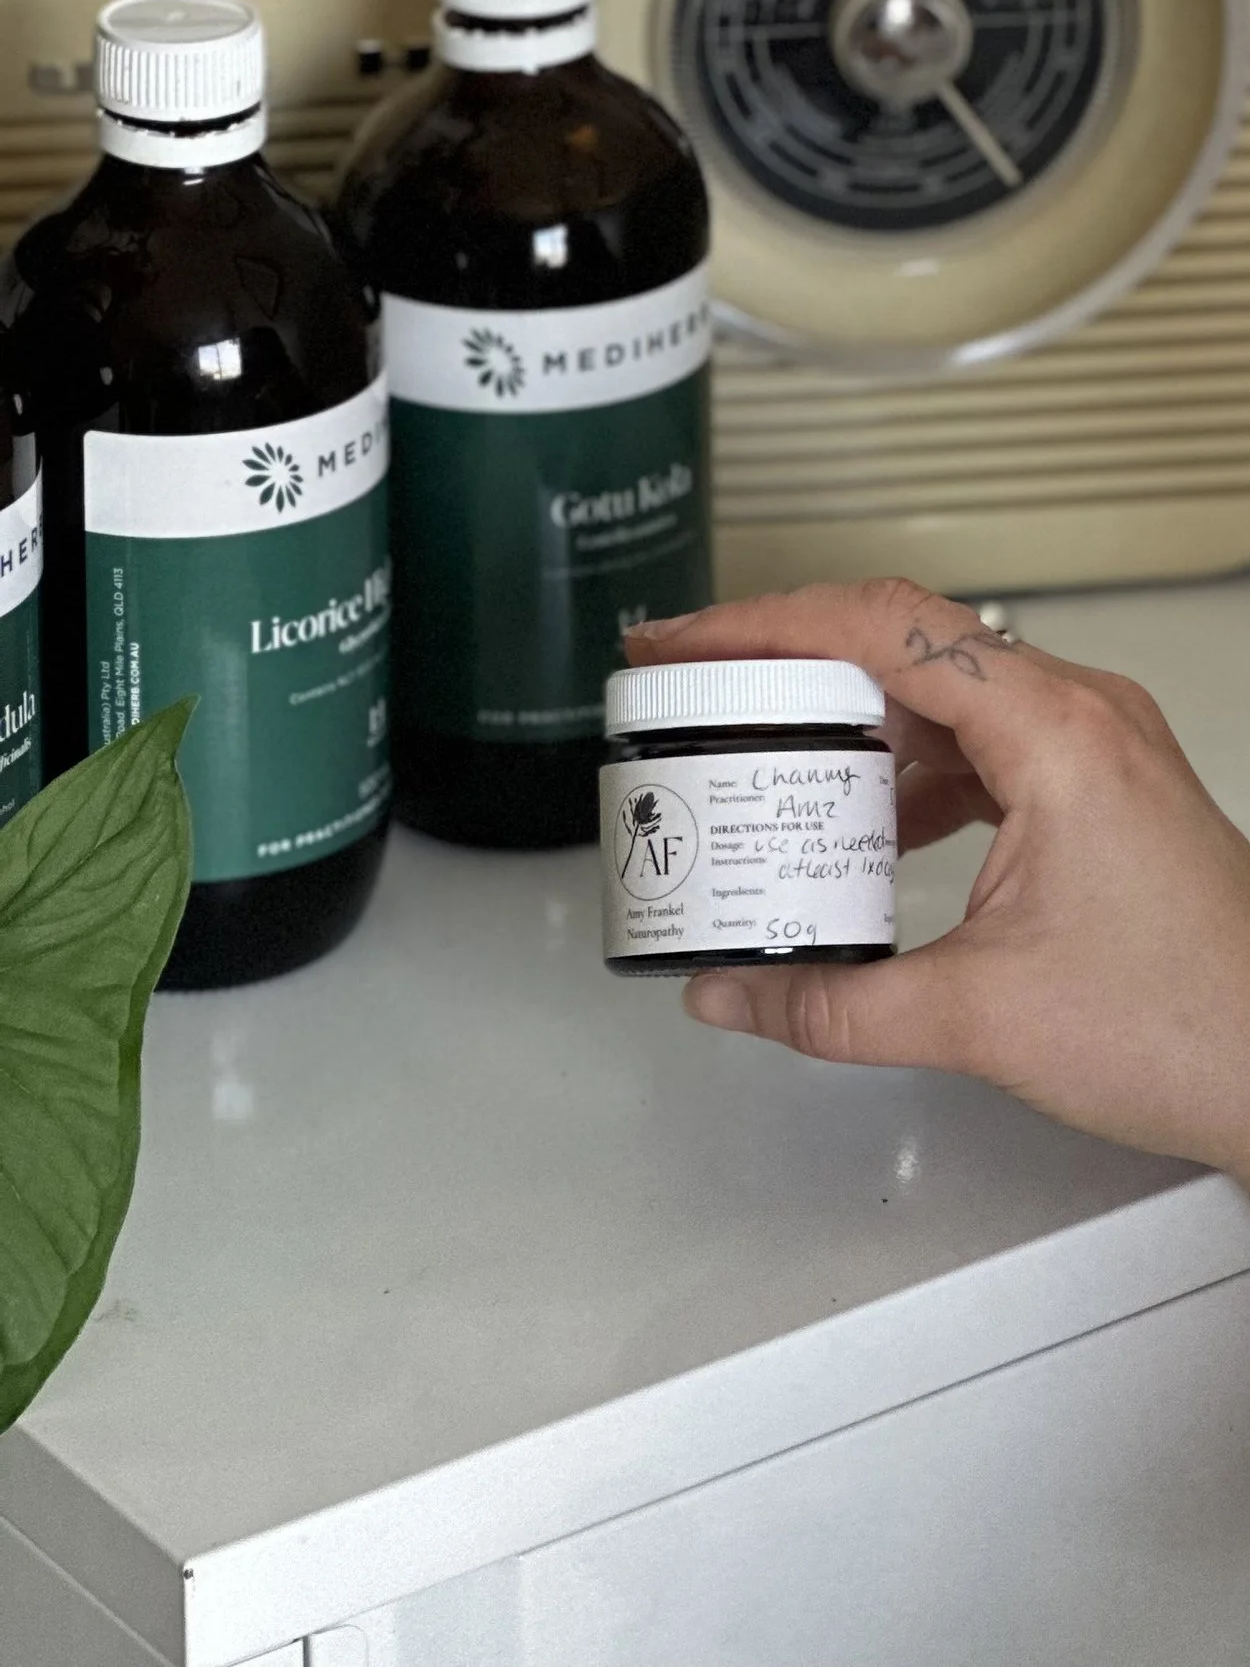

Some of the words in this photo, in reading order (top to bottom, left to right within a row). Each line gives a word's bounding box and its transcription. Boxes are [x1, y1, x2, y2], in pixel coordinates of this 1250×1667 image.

[113, 568, 124, 590] 4113
[113, 592, 124, 616] QLD
[251, 593, 364, 654] Licorice
[101, 661, 110, 679] Ltd
[115, 654, 125, 677] Mile
[101, 683, 111, 701] Pty
[115, 679, 126, 707] Eight
[710, 823, 778, 835] DIRECTIONS
[781, 822, 802, 832] FOR
[805, 821, 824, 831] USE
[640, 836, 683, 877] AF
[626, 908, 644, 923] Amy
[647, 902, 684, 919] Frankel
[627, 924, 685, 942] Naturopathy
